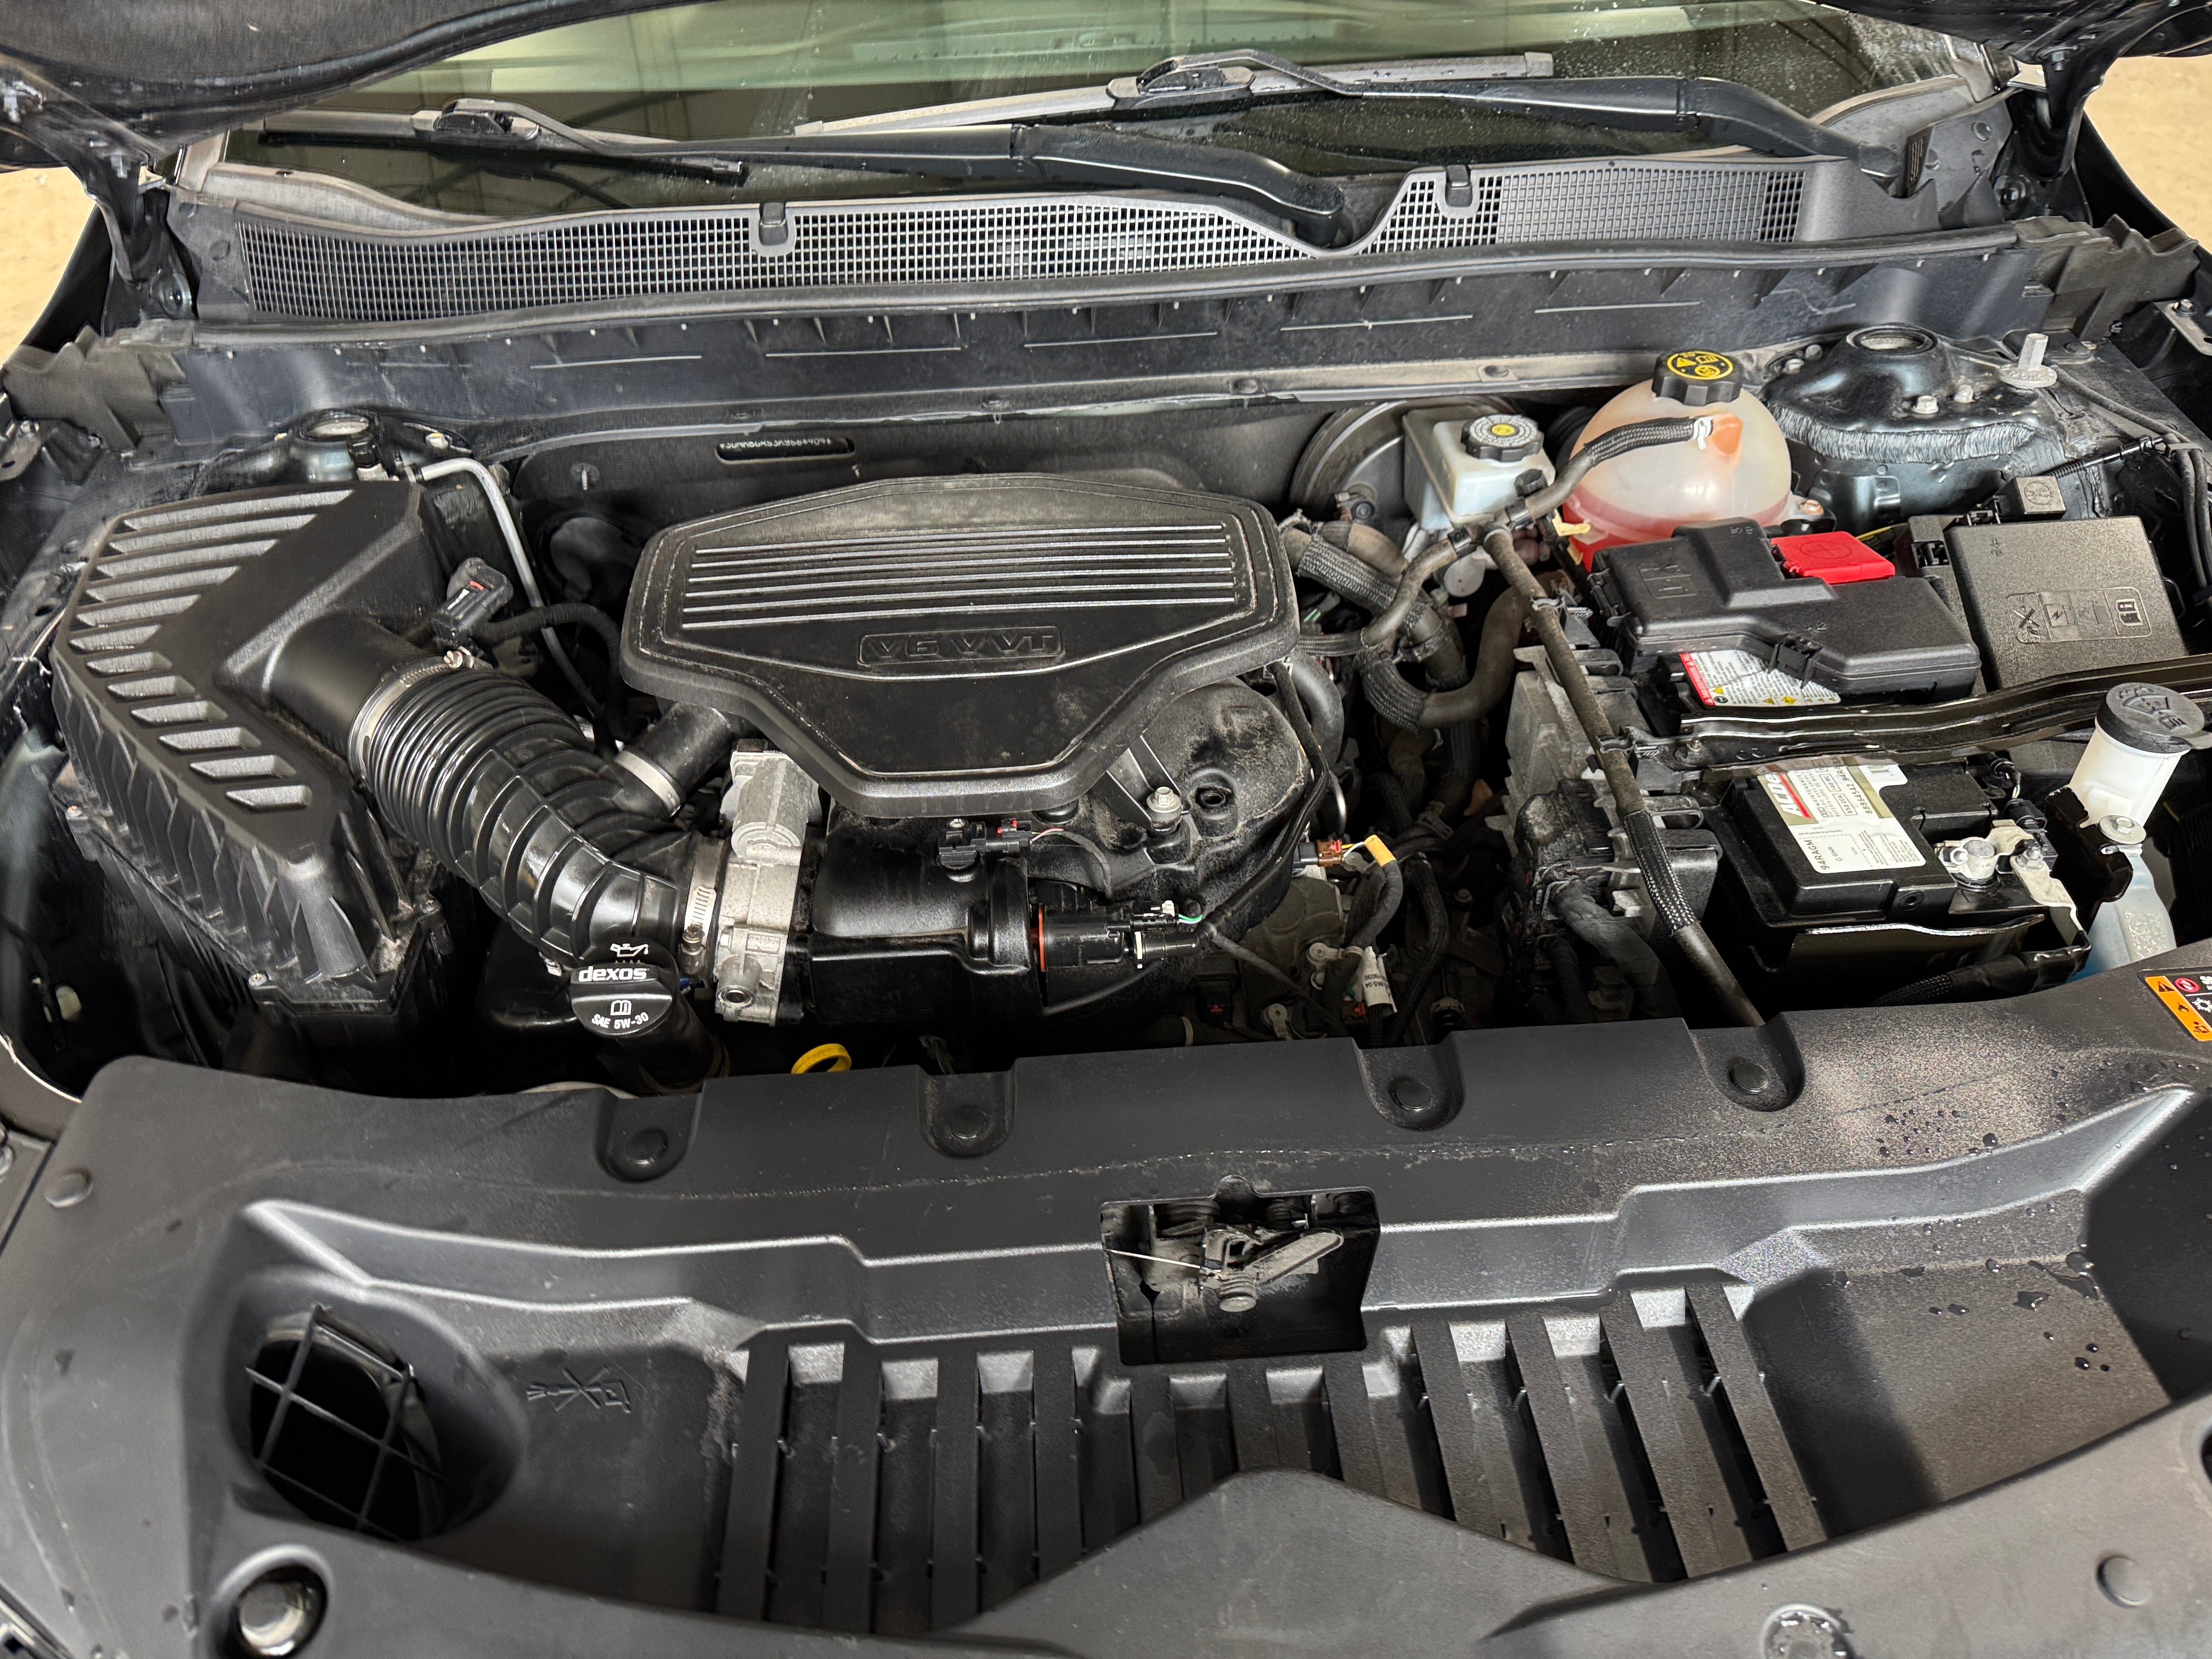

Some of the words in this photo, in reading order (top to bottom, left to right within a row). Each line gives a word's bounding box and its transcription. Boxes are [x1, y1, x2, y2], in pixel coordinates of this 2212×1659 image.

[869, 636, 939, 658] V6
[950, 633, 1054, 654] VVT
[1764, 772, 1803, 816] ACDe
[1837, 795, 1847, 804] CCA
[1843, 804, 1853, 813] 850
[1804, 840, 1830, 870] 94RAGM
[578, 966, 647, 982] dexos
[591, 1013, 611, 1029] SAE
[614, 1012, 649, 1029] 5W-30
